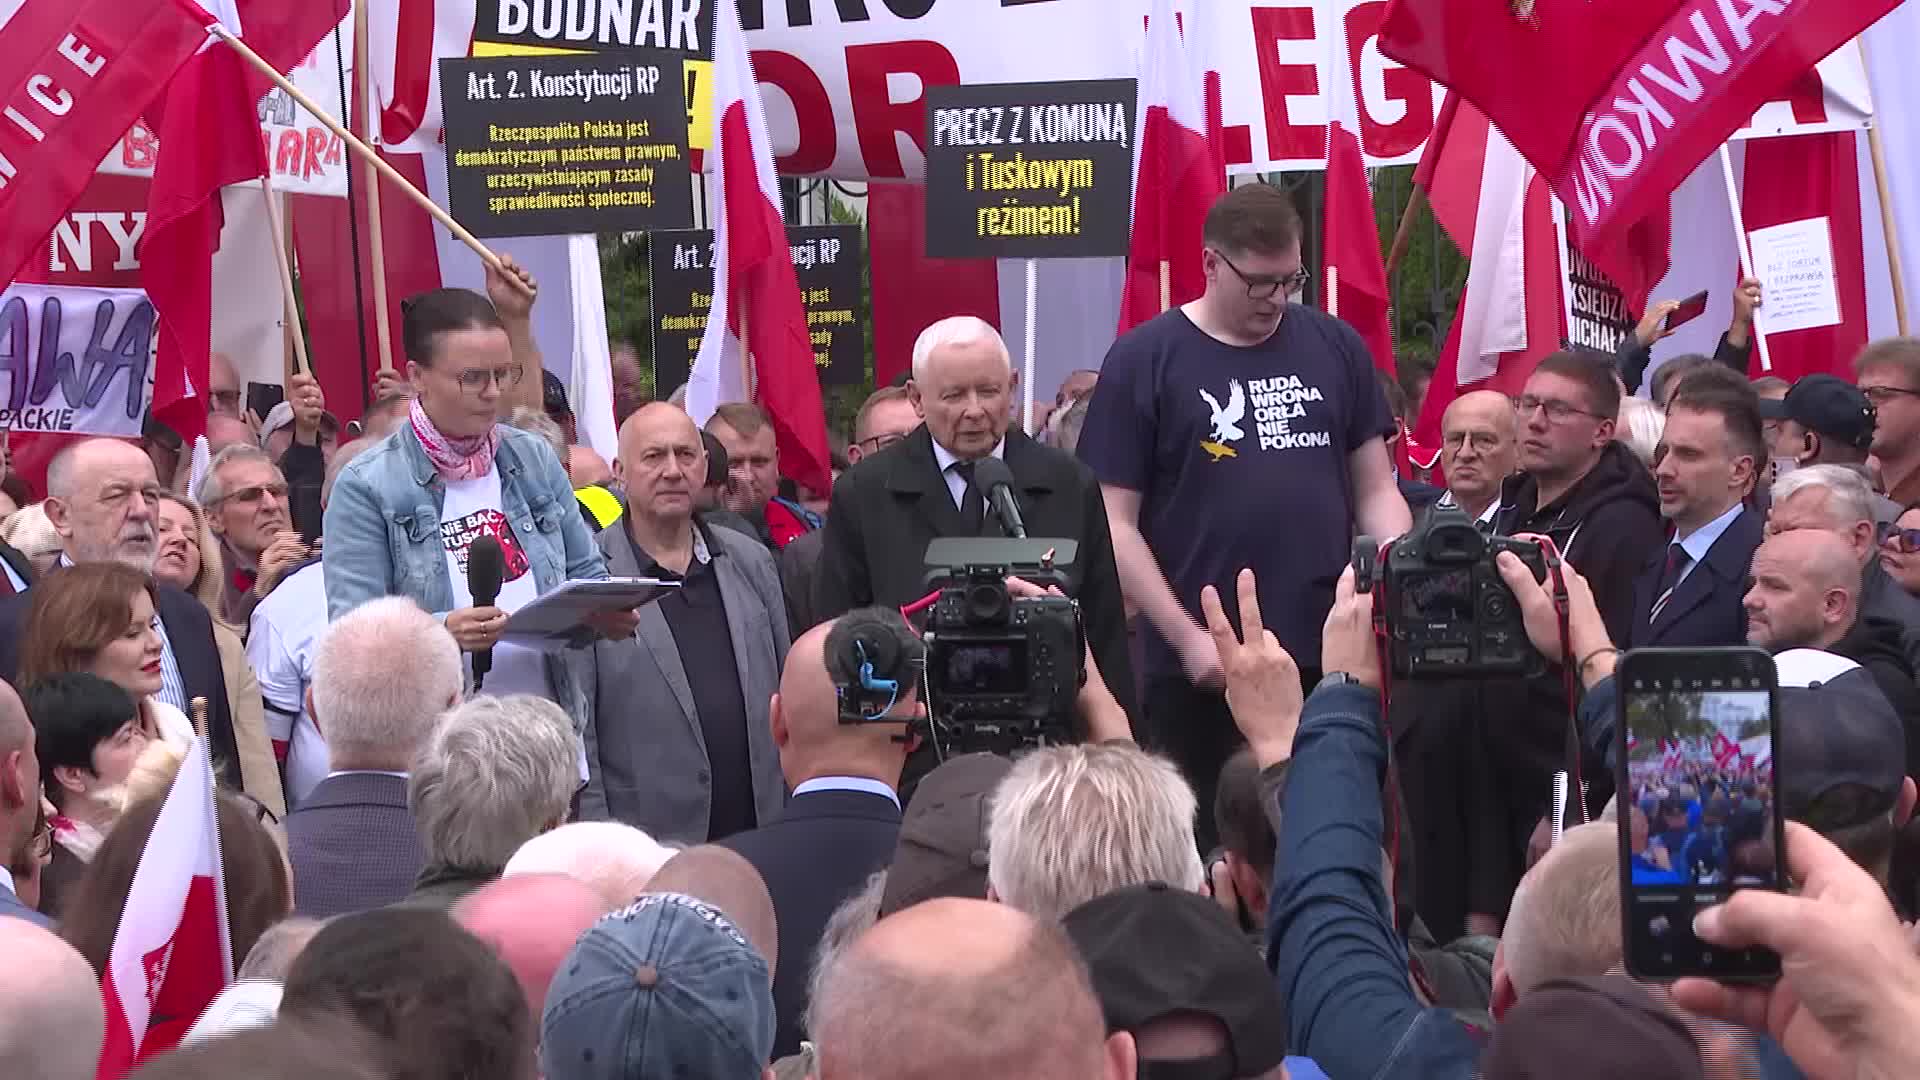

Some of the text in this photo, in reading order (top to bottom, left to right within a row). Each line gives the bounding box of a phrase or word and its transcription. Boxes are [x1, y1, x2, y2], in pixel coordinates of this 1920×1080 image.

[467, 66, 660, 103] Art. 2. Konstytucji RP
[489, 119, 650, 144] Rzeczpospolita Polska jest
[934, 103, 1128, 149] PRECZ Z KOMUNĄ
[455, 143, 681, 168] demokratycznym państwem prawnym,
[487, 165, 654, 190] urzeczywistniającym zasady
[966, 151, 1094, 197] i Tuskowym
[488, 187, 656, 214] sprawiedliwości społecznej.
[976, 196, 1081, 236] reżimem!
[819, 238, 841, 264] RP
[1248, 375, 1304, 394] RUDA
[1250, 387, 1324, 408] WRONA
[1253, 402, 1307, 422] ORŁA
[1256, 420, 1291, 436] NIE
[1259, 432, 1331, 451] POKONA
